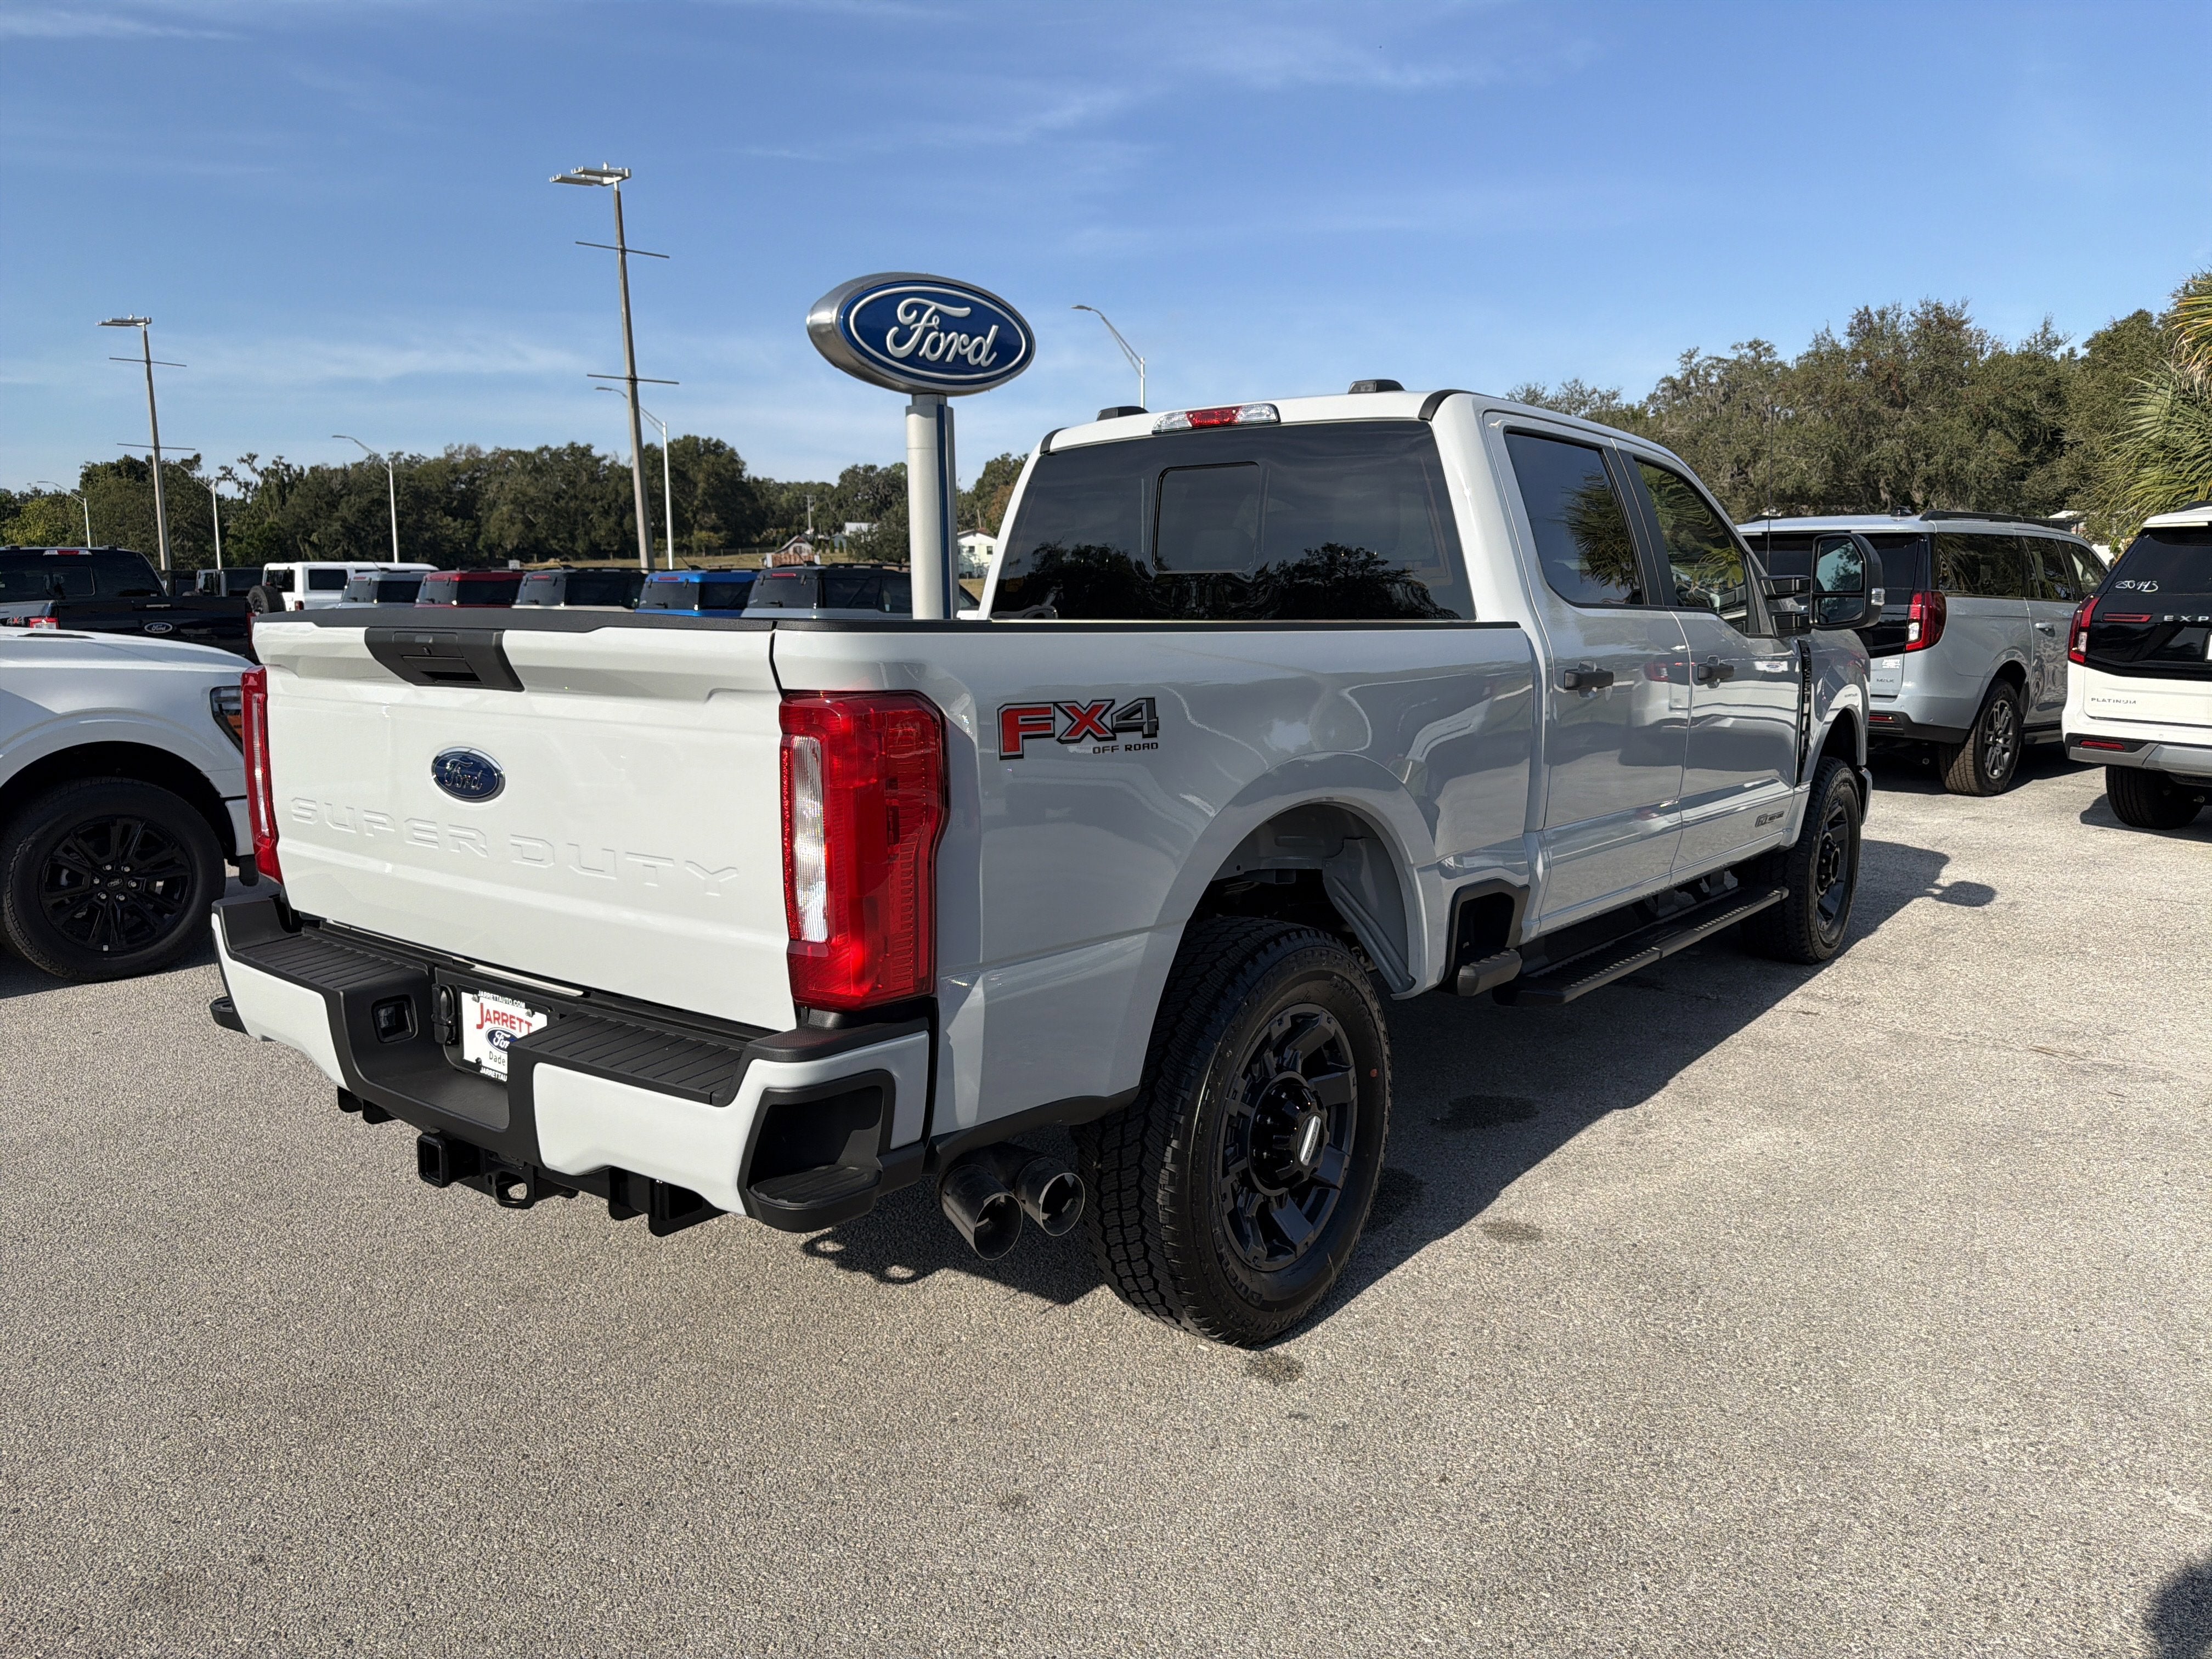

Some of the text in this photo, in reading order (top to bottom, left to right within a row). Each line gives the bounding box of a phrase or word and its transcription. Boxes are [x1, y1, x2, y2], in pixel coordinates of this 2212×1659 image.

[886, 297, 999, 367] Ford
[996, 696, 1159, 761] FX4
[1092, 742, 1159, 755] OFF ROAD
[444, 758, 483, 791] Ford
[291, 797, 740, 896] SUPER DUTY
[478, 990, 526, 1009] JARRETTAUTO.COM
[476, 1003, 533, 1036] JARRETT
[493, 1030, 510, 1049] For
[489, 1051, 506, 1066] Dade
